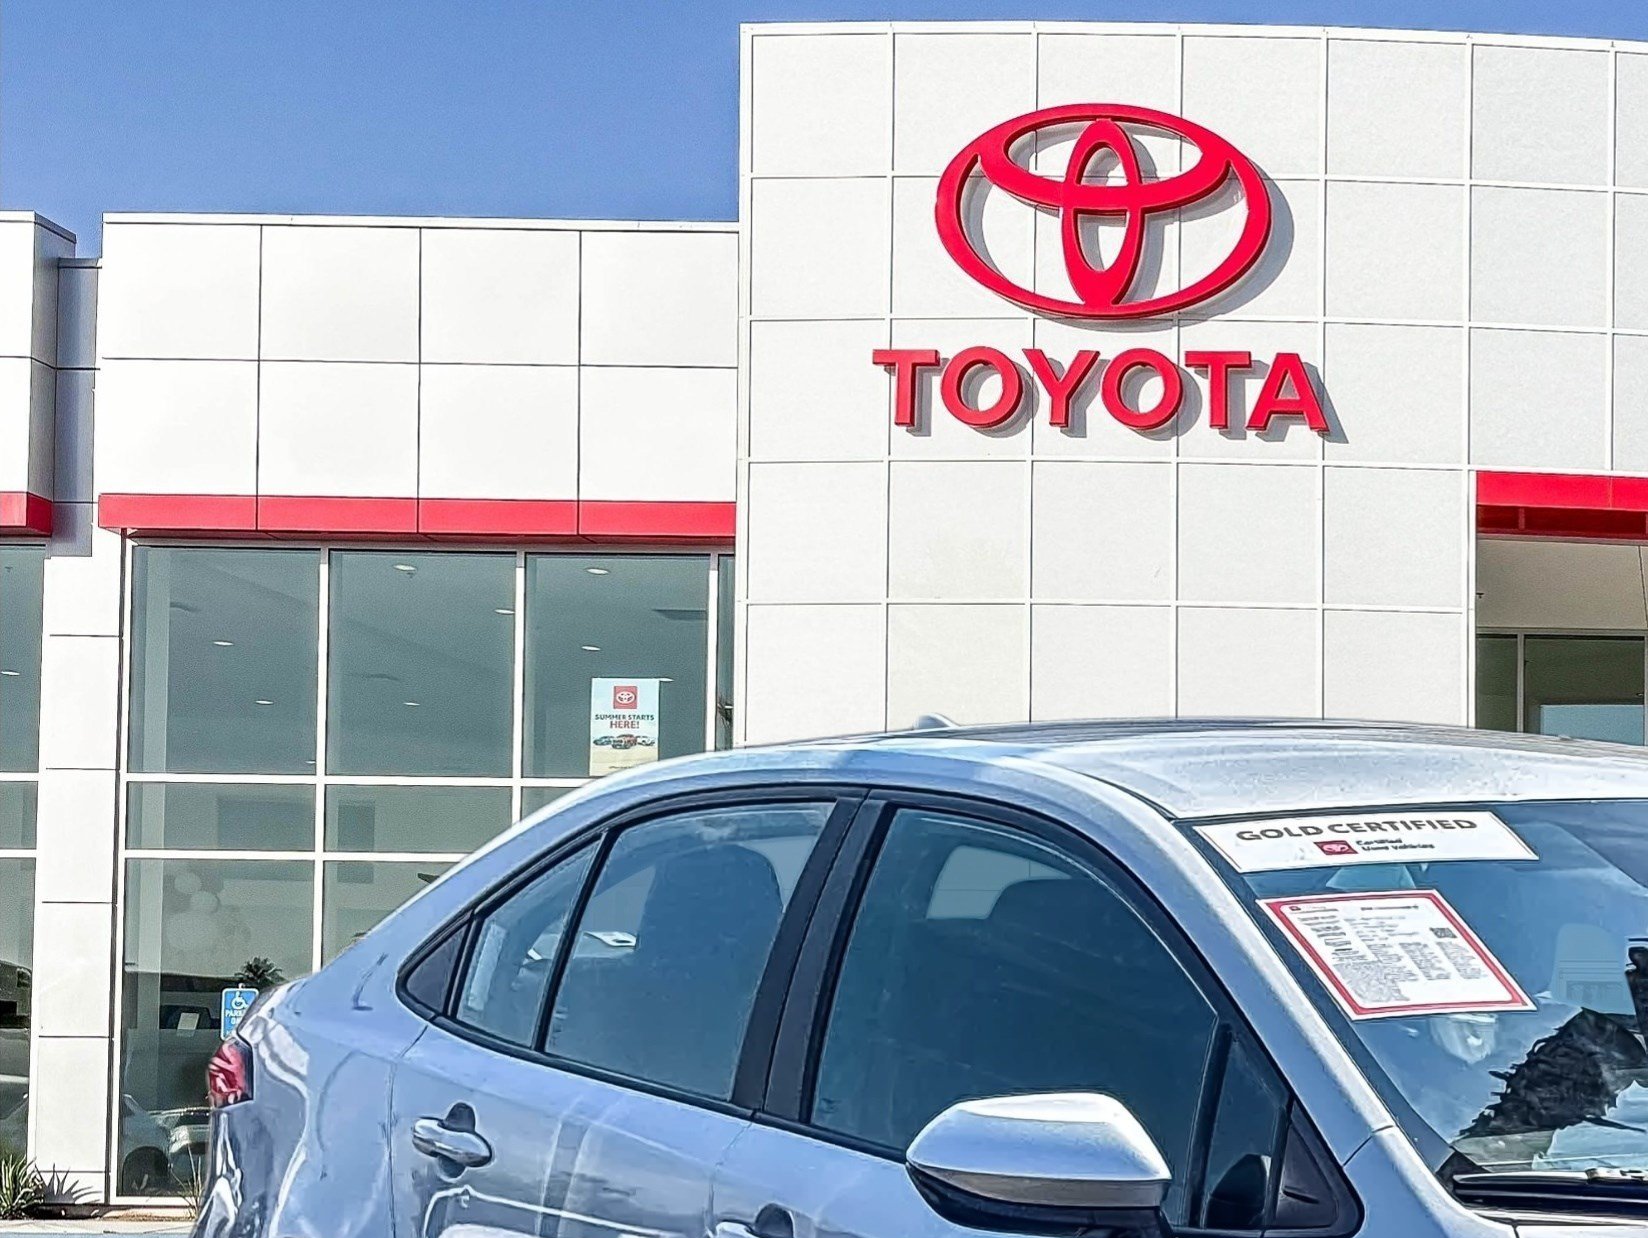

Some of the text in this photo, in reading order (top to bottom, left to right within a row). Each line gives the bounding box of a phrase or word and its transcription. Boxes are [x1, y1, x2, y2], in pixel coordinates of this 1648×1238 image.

[872, 345, 1329, 432] TOYOTA
[610, 721, 640, 729] HERE!
[1236, 818, 1478, 841] GOLD CERTIFIED
